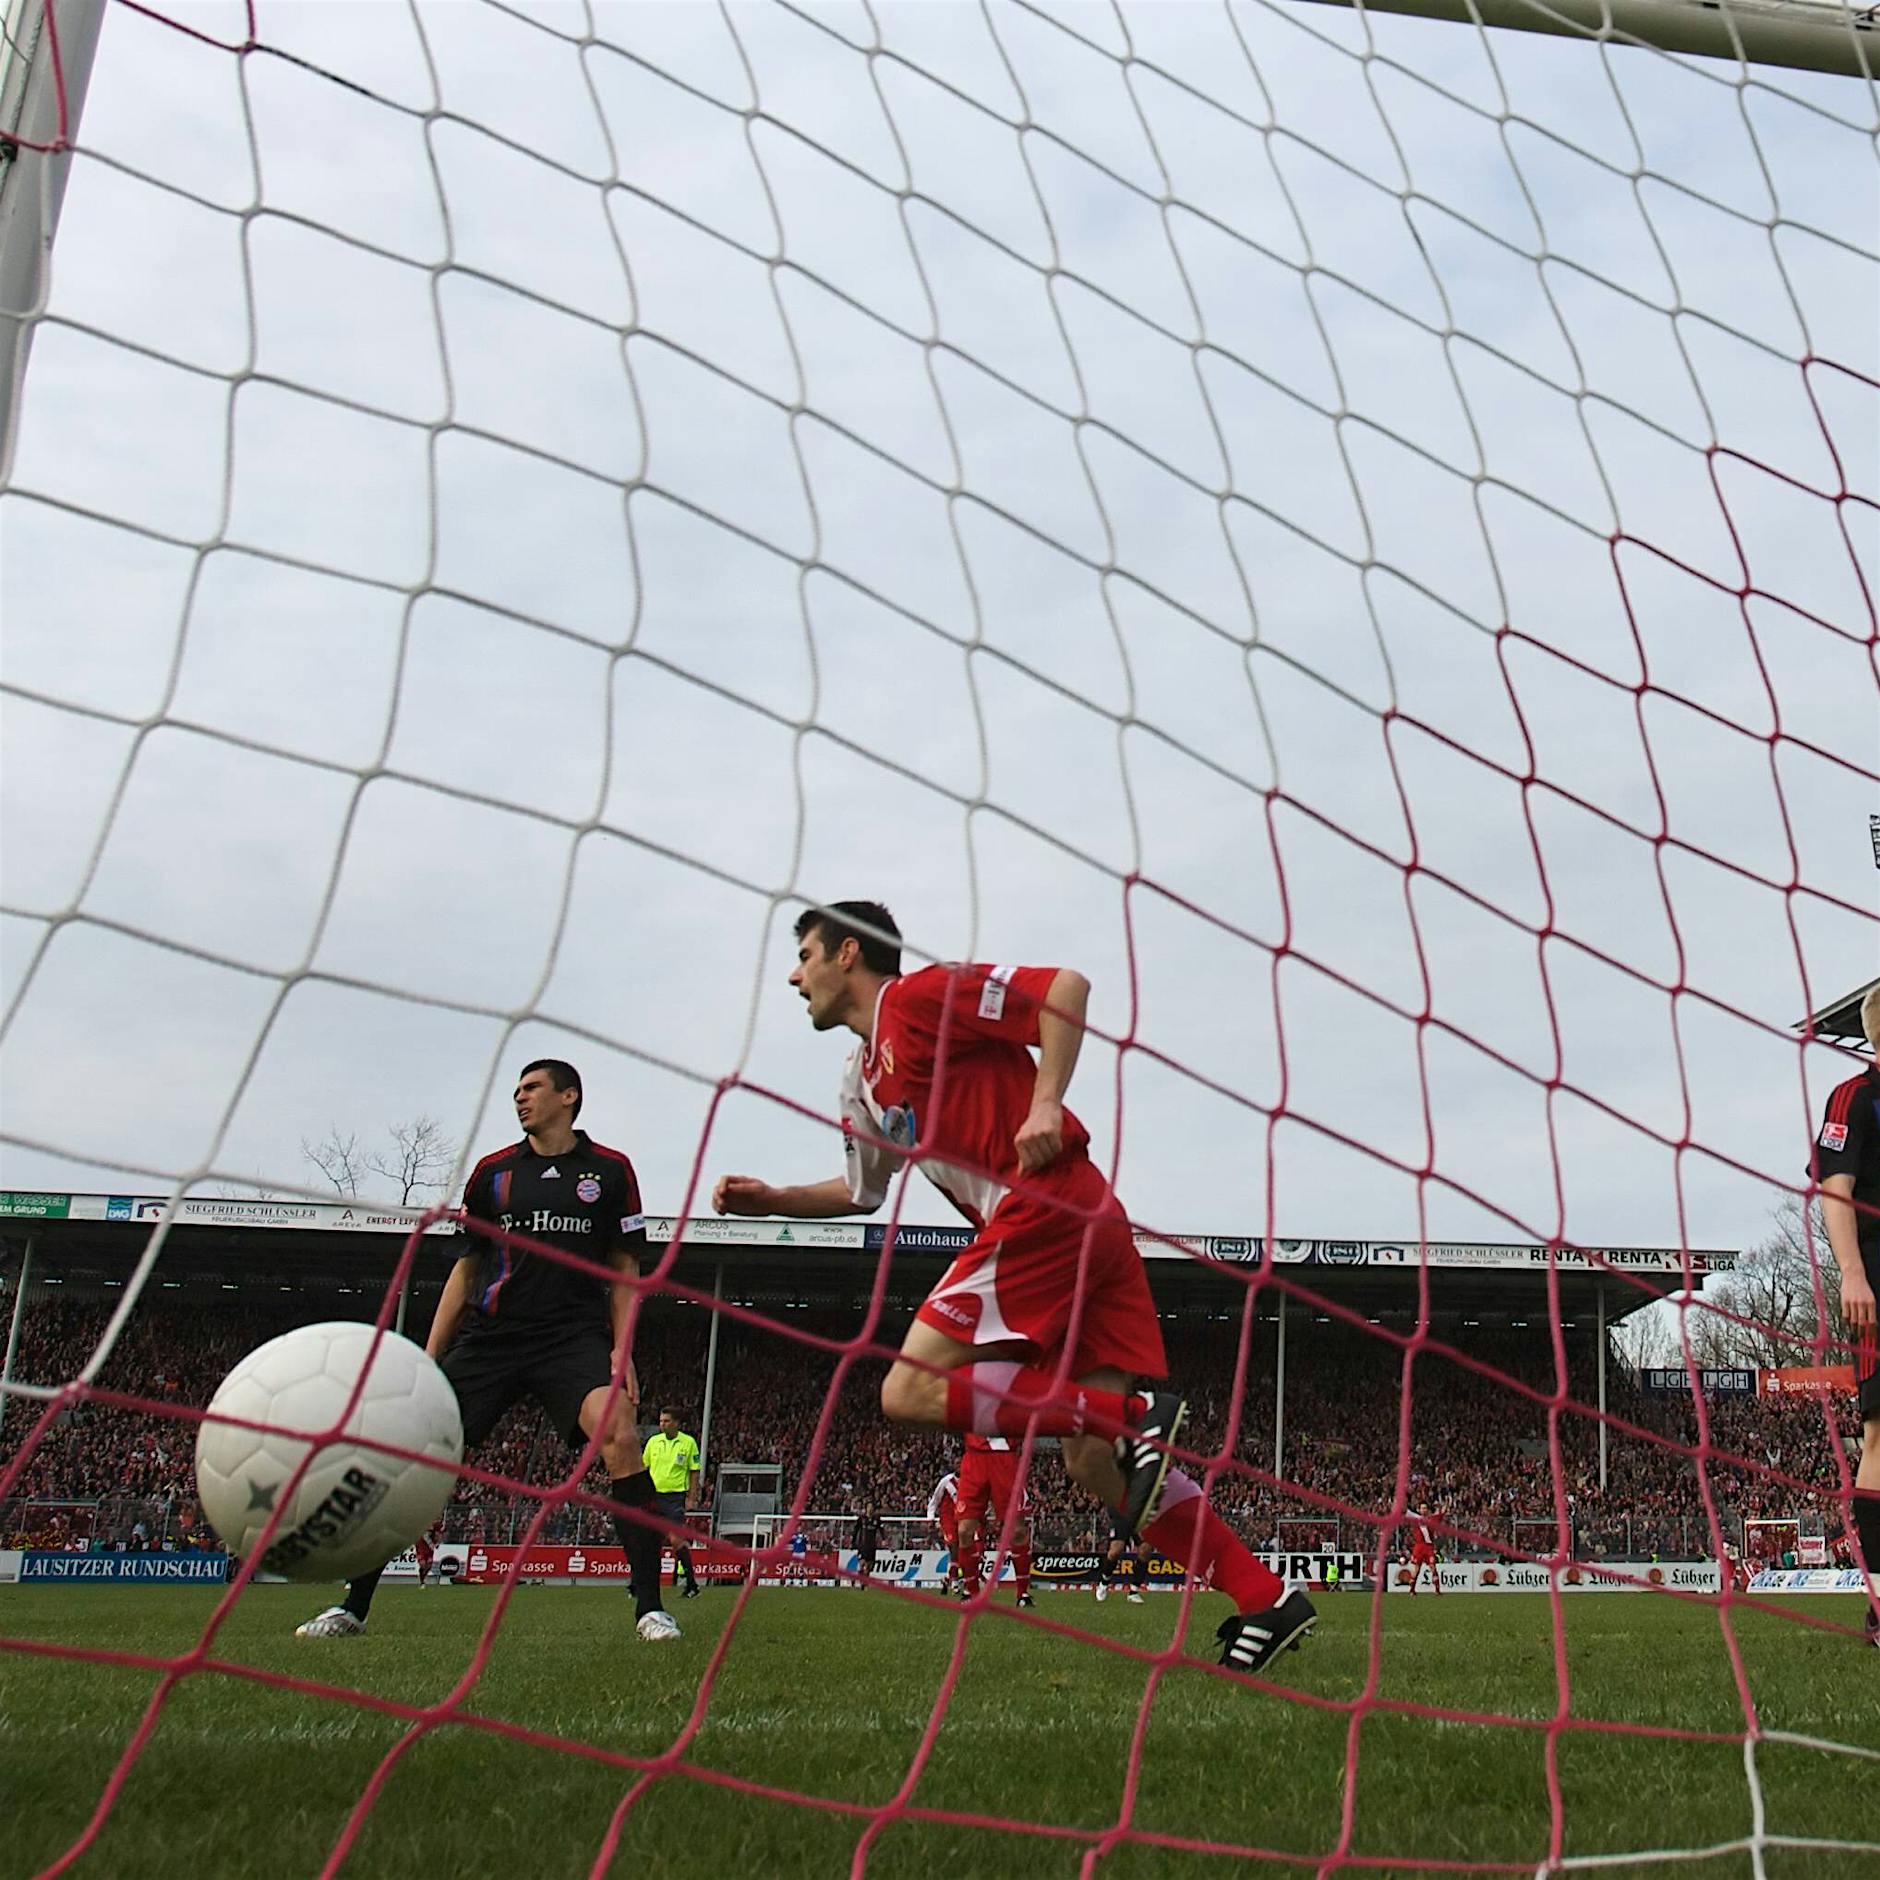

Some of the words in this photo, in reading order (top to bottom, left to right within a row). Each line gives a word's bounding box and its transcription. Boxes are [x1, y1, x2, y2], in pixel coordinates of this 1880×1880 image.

[185, 1204, 244, 1215] SIEGFRIED
[896, 1231, 968, 1247] Autohaus
[1609, 1252, 1662, 1264] RENTA
[1707, 1260, 1735, 1271] LIGA
[1324, 1544, 1335, 1553] 20
[22, 1558, 114, 1577] LAUSITZER
[118, 1559, 225, 1577] RUNDSCHAU
[492, 1559, 555, 1573] Spakasse
[1671, 1568, 1716, 1586] Lübzer
